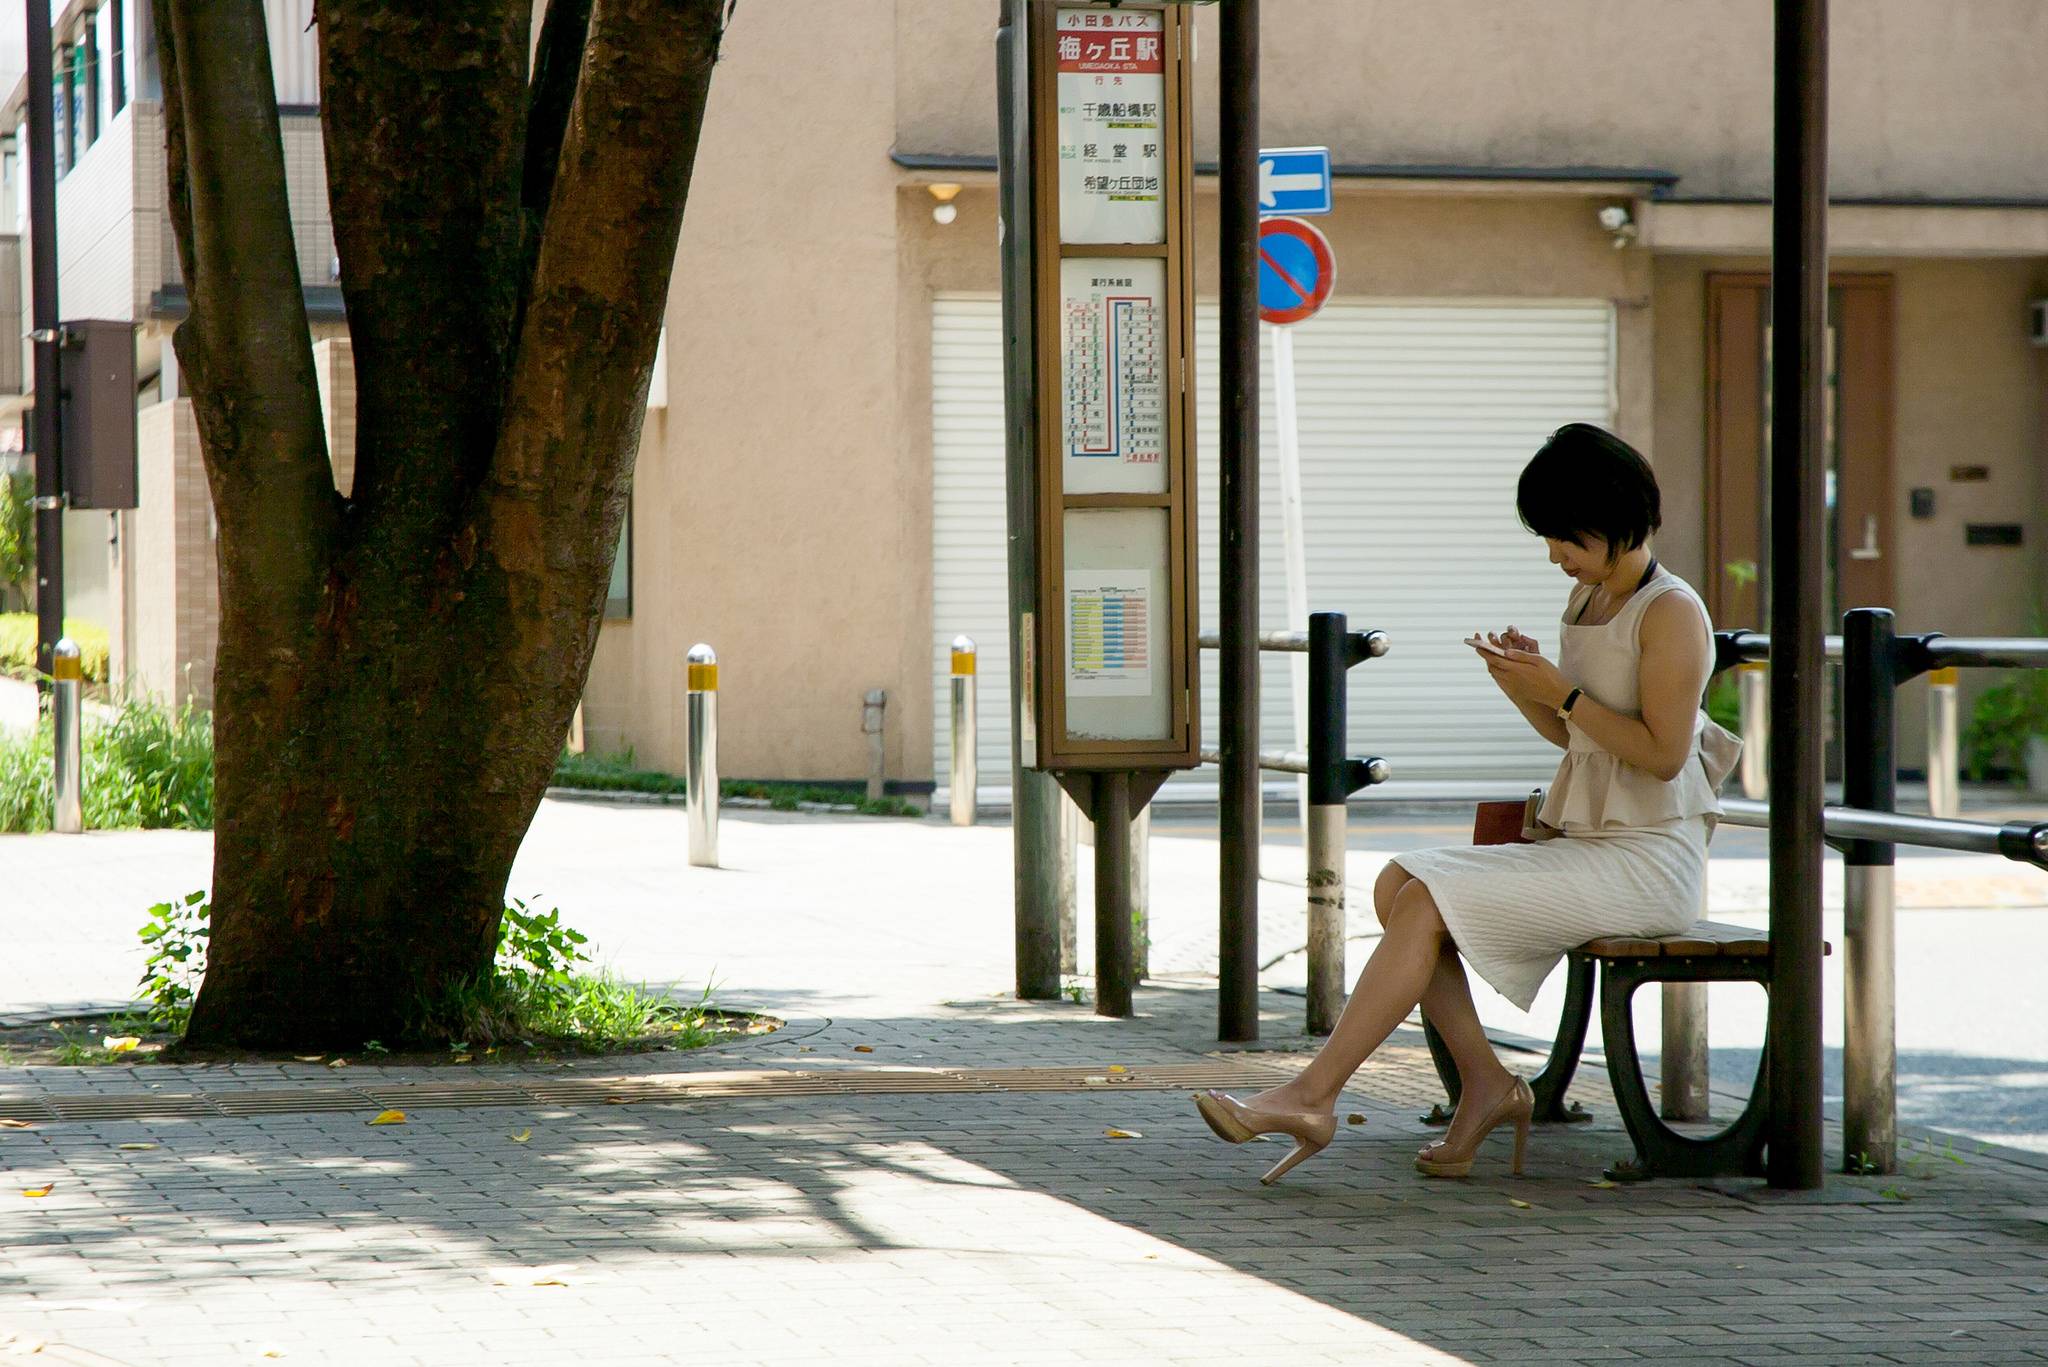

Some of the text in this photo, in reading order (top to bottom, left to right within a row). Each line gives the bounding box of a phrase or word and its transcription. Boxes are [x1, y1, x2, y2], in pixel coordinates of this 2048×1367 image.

[1067, 14, 1150, 27] 小田急バス
[1082, 102, 1157, 118] 千歳船橋駅
